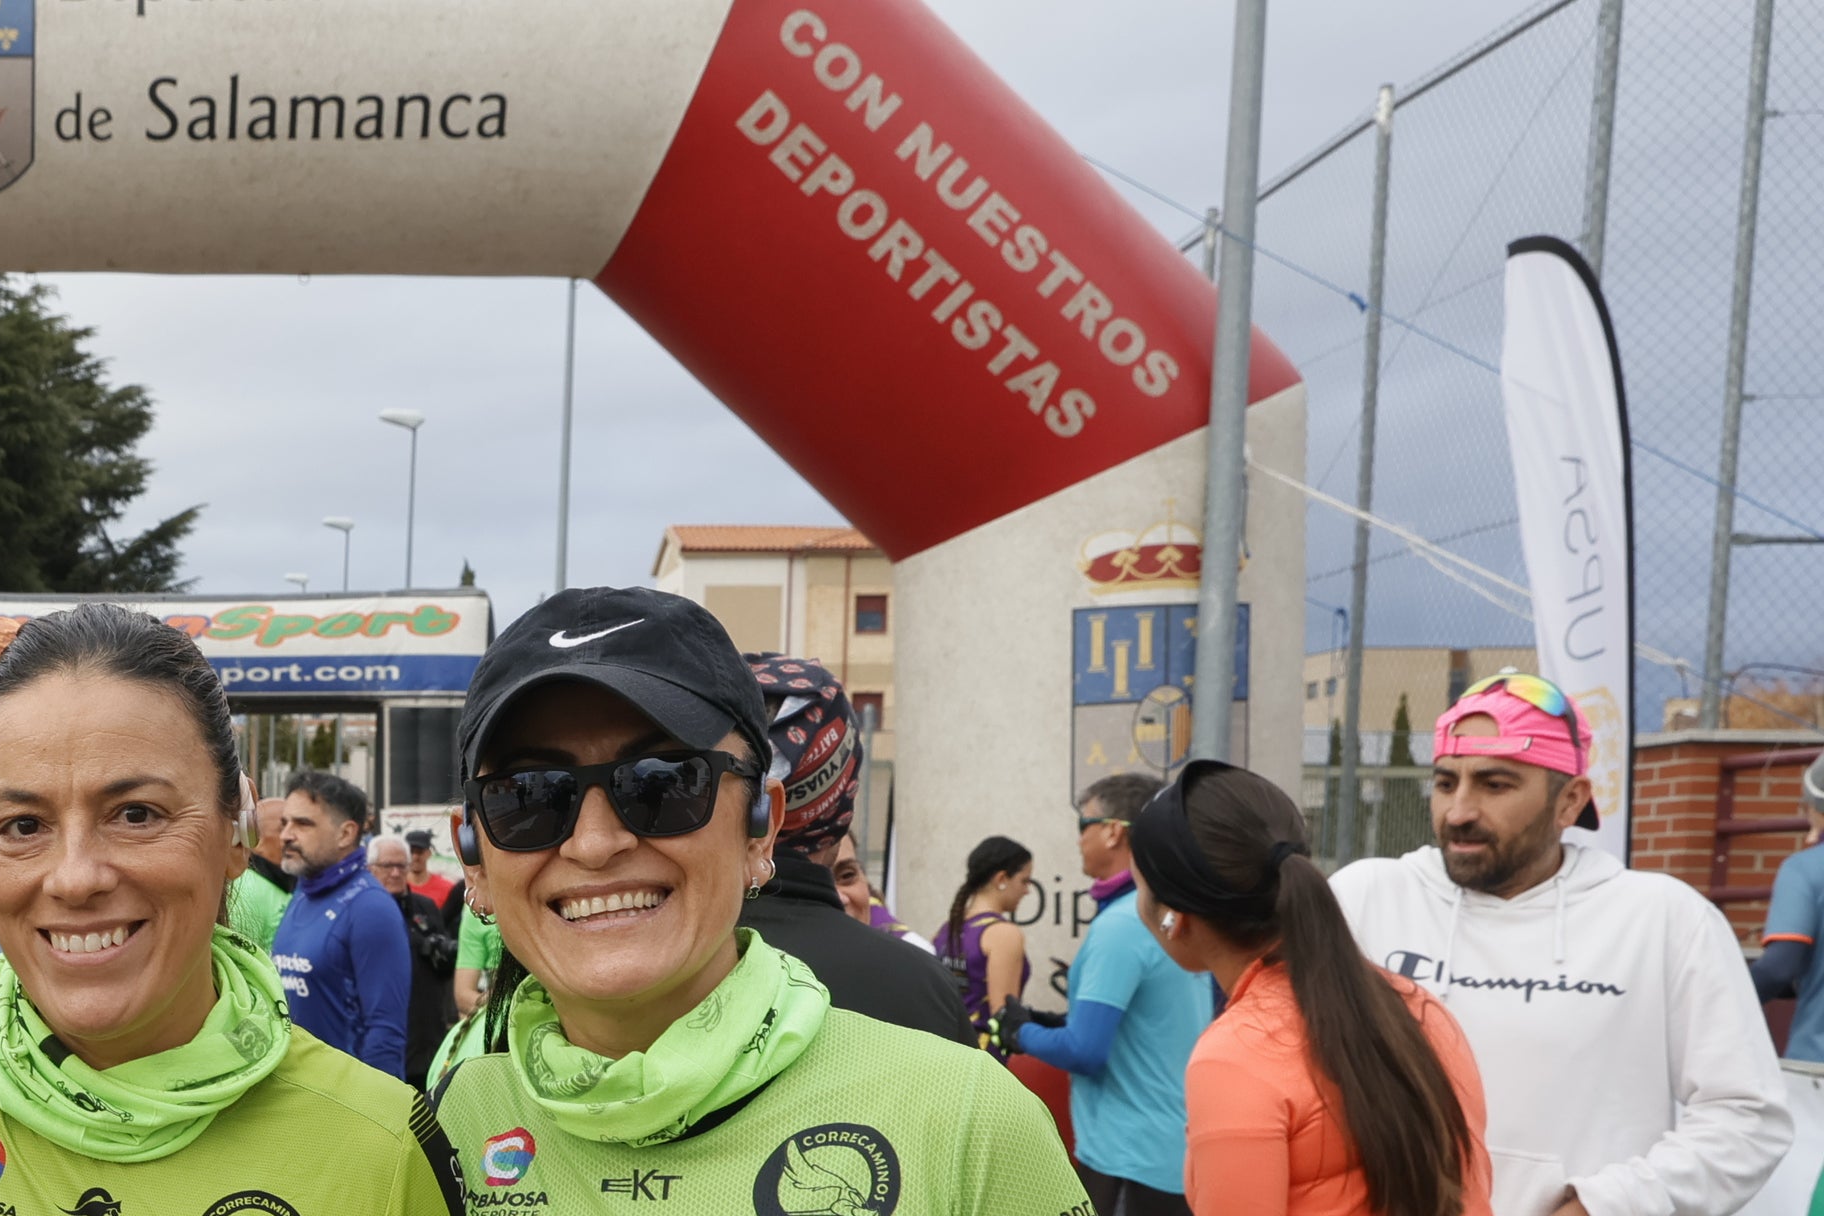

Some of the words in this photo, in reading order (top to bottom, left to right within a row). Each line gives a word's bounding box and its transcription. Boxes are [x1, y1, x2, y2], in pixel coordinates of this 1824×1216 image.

[54, 92, 113, 142] de
[145, 74, 509, 143] Salamanca
[779, 9, 904, 132] CON
[894, 122, 1181, 398] NUESTROS
[735, 89, 1097, 438] DEPORTISTAS
[802, 1130, 890, 1203] CORRECAMINOS
